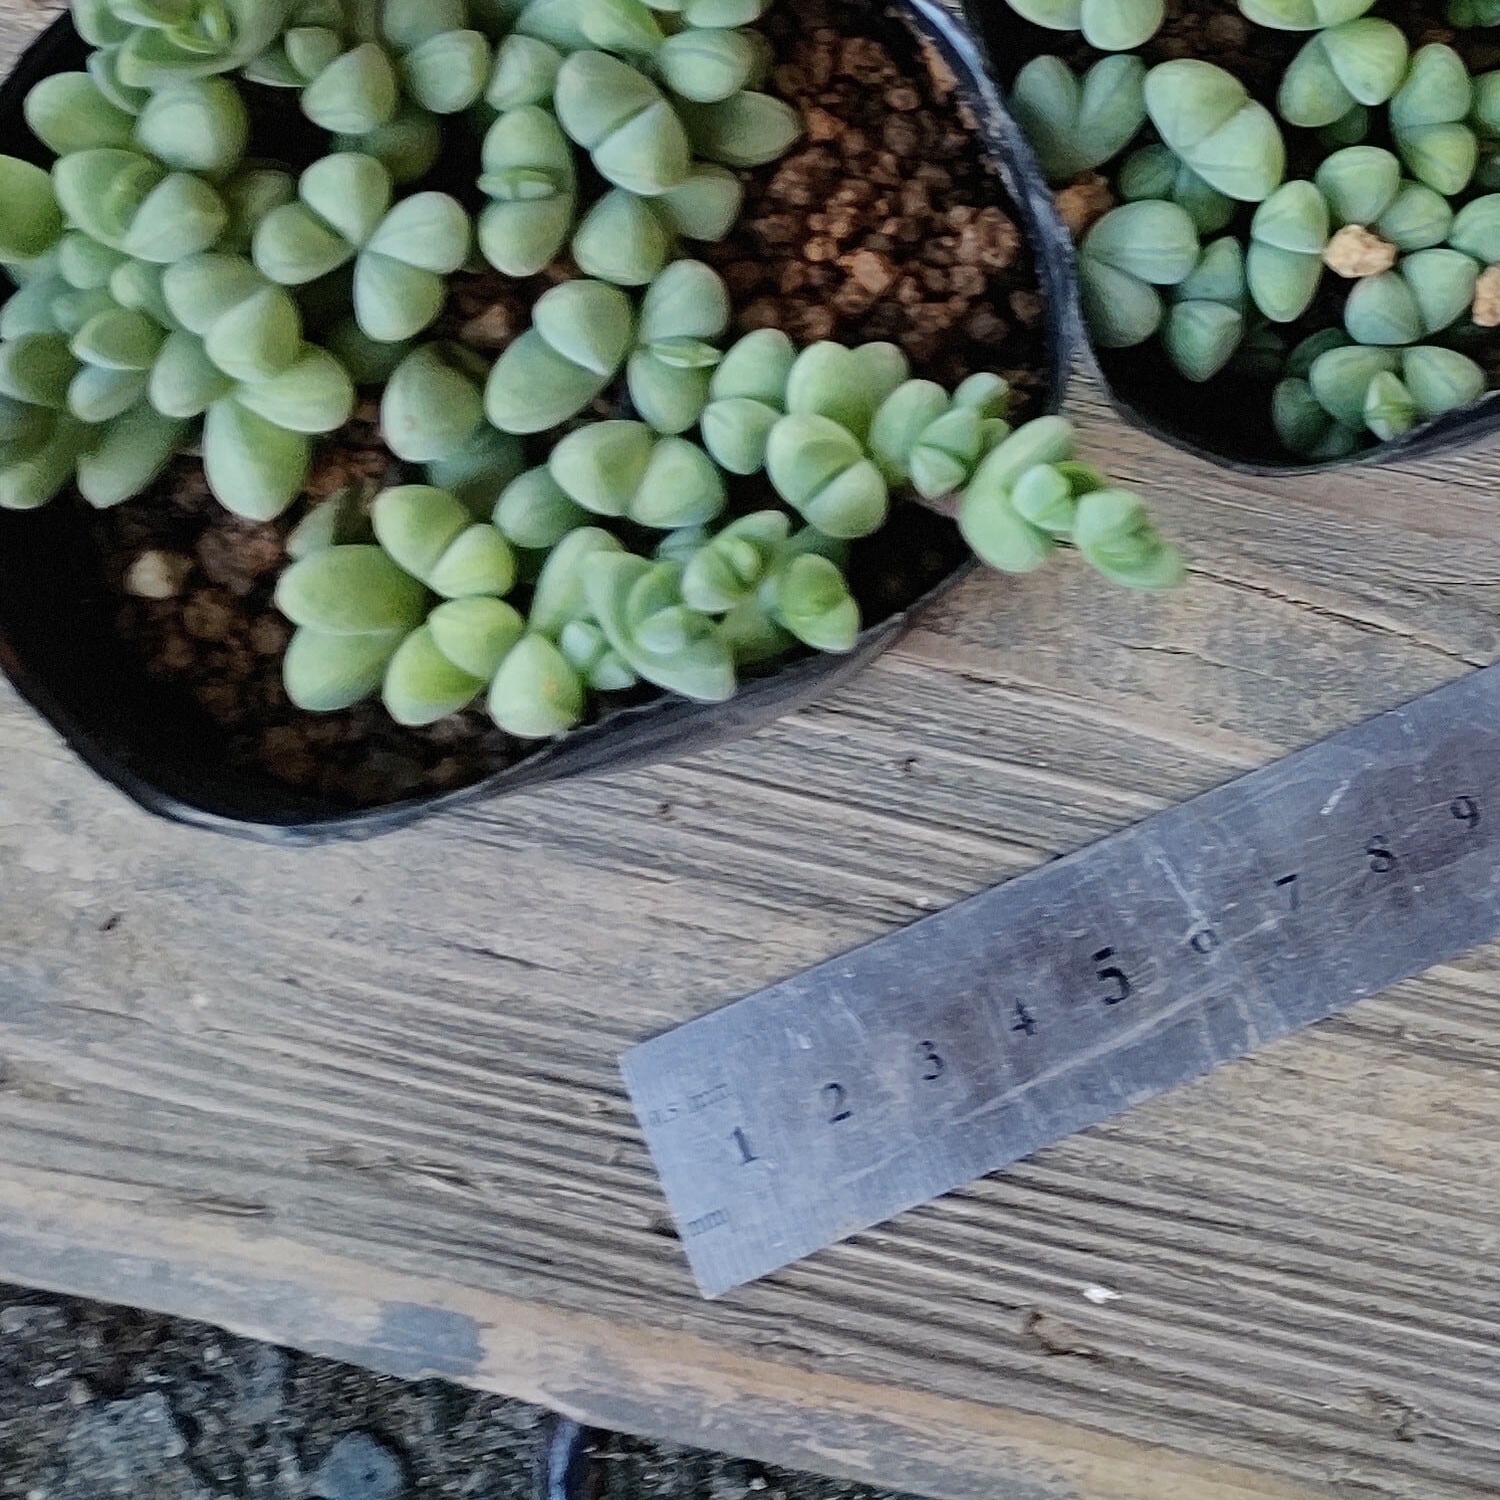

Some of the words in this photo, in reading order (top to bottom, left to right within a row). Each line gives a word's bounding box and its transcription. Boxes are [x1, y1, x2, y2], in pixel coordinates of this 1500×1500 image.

[726, 1125, 760, 1166] 1
[819, 1081, 853, 1124] 2
[914, 1039, 944, 1081] 3
[1010, 998, 1038, 1037] 4
[1092, 946, 1134, 1005] 5
[1449, 795, 1481, 830] 9
